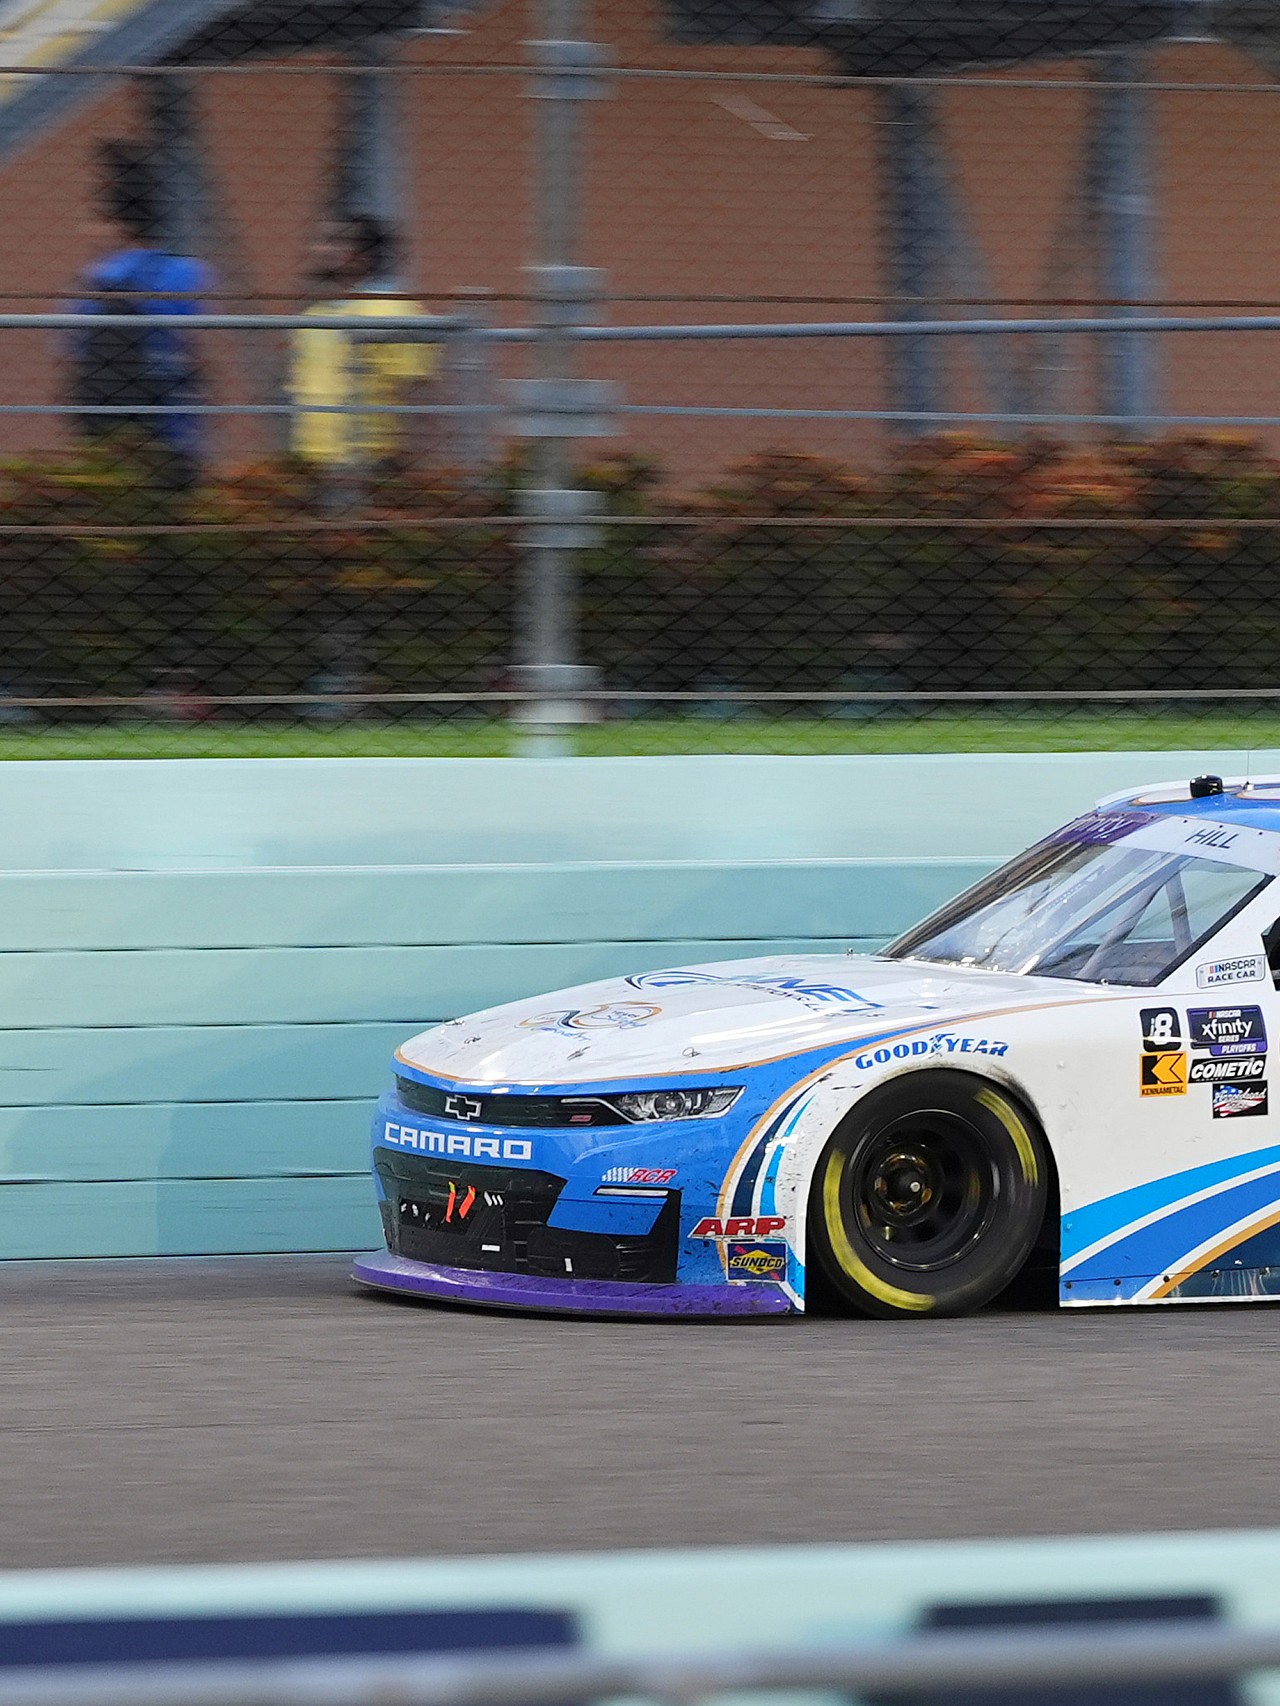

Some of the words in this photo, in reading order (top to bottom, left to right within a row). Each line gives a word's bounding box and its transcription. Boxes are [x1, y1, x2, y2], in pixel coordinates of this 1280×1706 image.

[1184, 829, 1239, 849] HILL
[1218, 959, 1256, 972] NASCAR
[1208, 973, 1233, 983] RACE
[1236, 970, 1256, 979] CAR
[1202, 1020, 1252, 1040] xfinity
[856, 1035, 1008, 1071] GOODYEAR
[1221, 1044, 1257, 1054] PLAYOFFS
[1191, 1059, 1264, 1079] COMETIC
[1141, 1086, 1184, 1096] KENNAMETAL
[384, 1122, 533, 1160] CAMARO
[626, 1168, 677, 1184] RCR
[692, 1217, 786, 1236] ARP
[731, 1256, 784, 1269] SUNOCO
